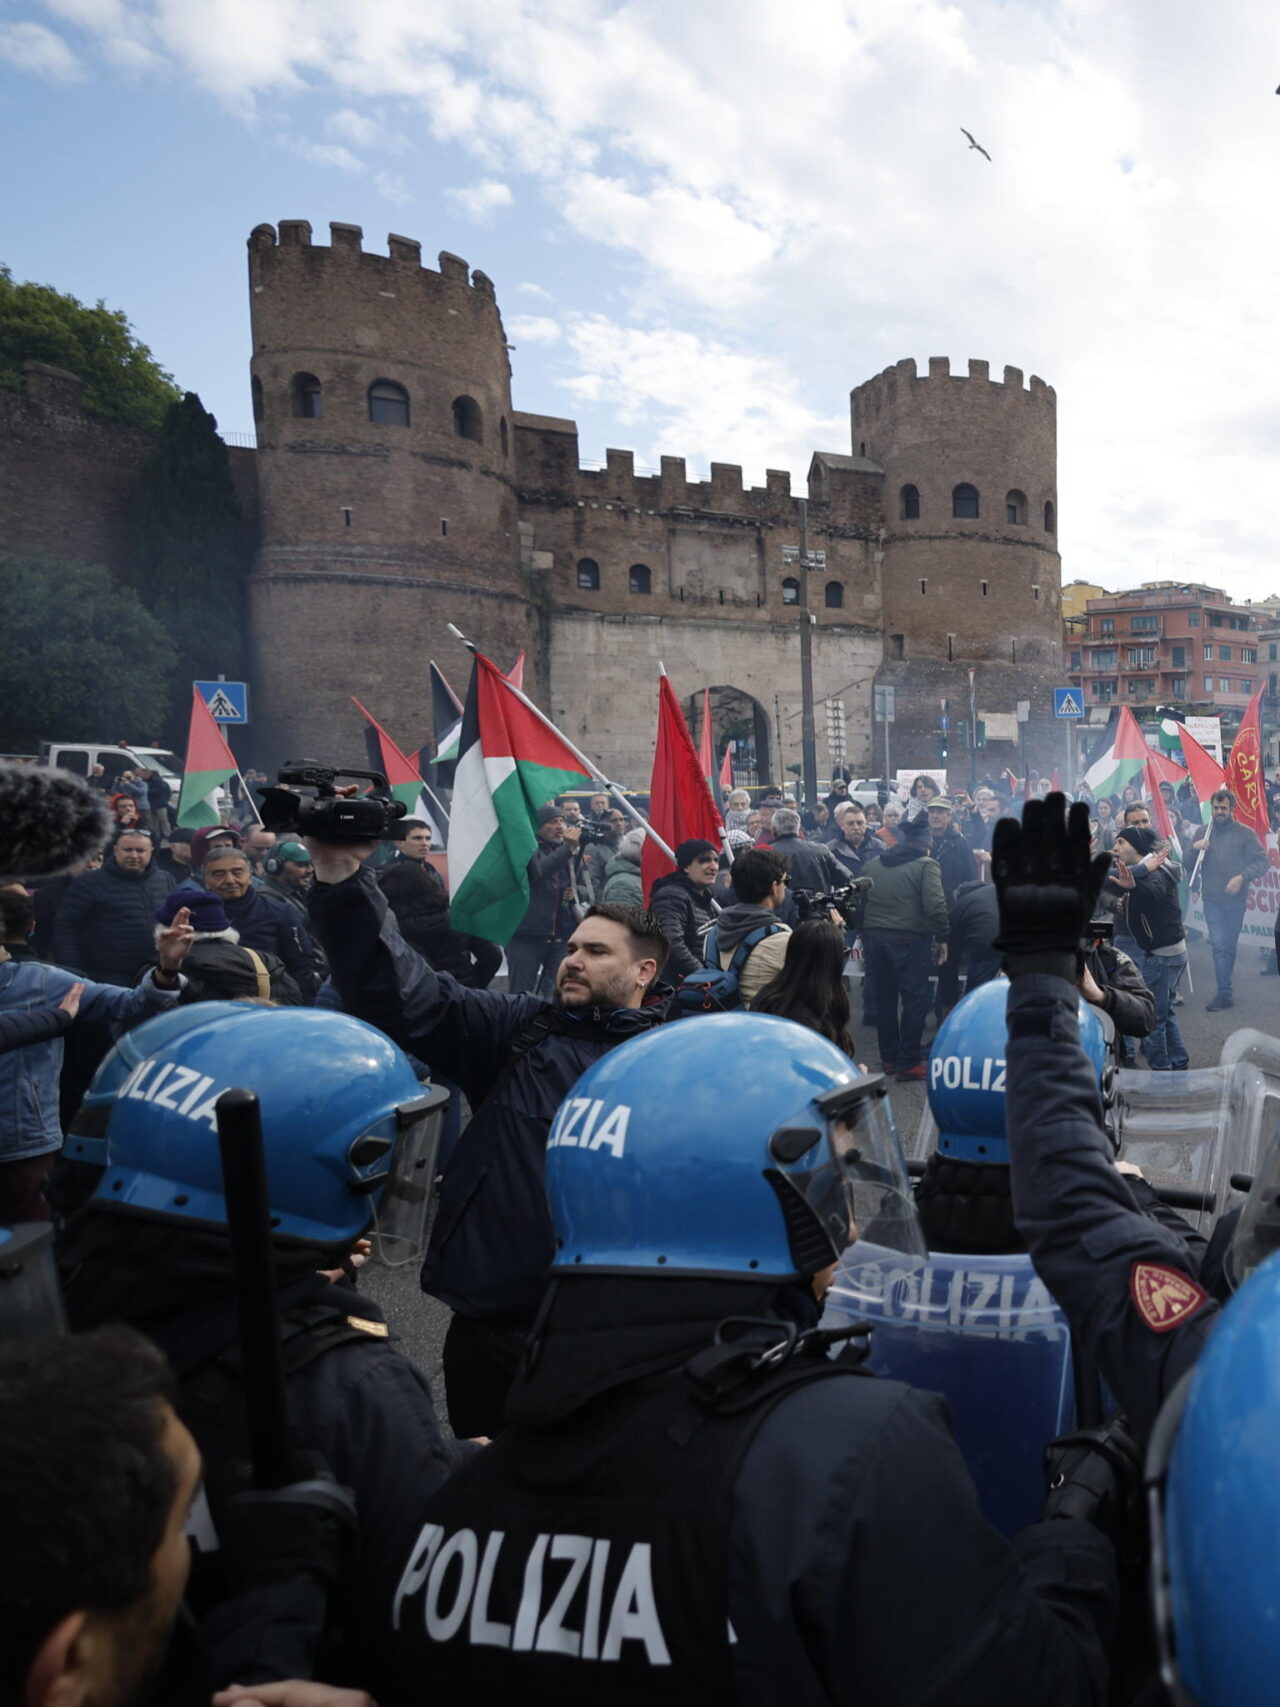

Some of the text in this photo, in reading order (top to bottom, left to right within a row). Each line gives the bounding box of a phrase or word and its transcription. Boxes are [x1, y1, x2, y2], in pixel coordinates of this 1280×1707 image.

[118, 1059, 231, 1134] OLIZIA
[931, 1055, 1007, 1093] POLIZ
[858, 1262, 1062, 1344] POLIZIA
[391, 1523, 672, 1666] POLIZIA
